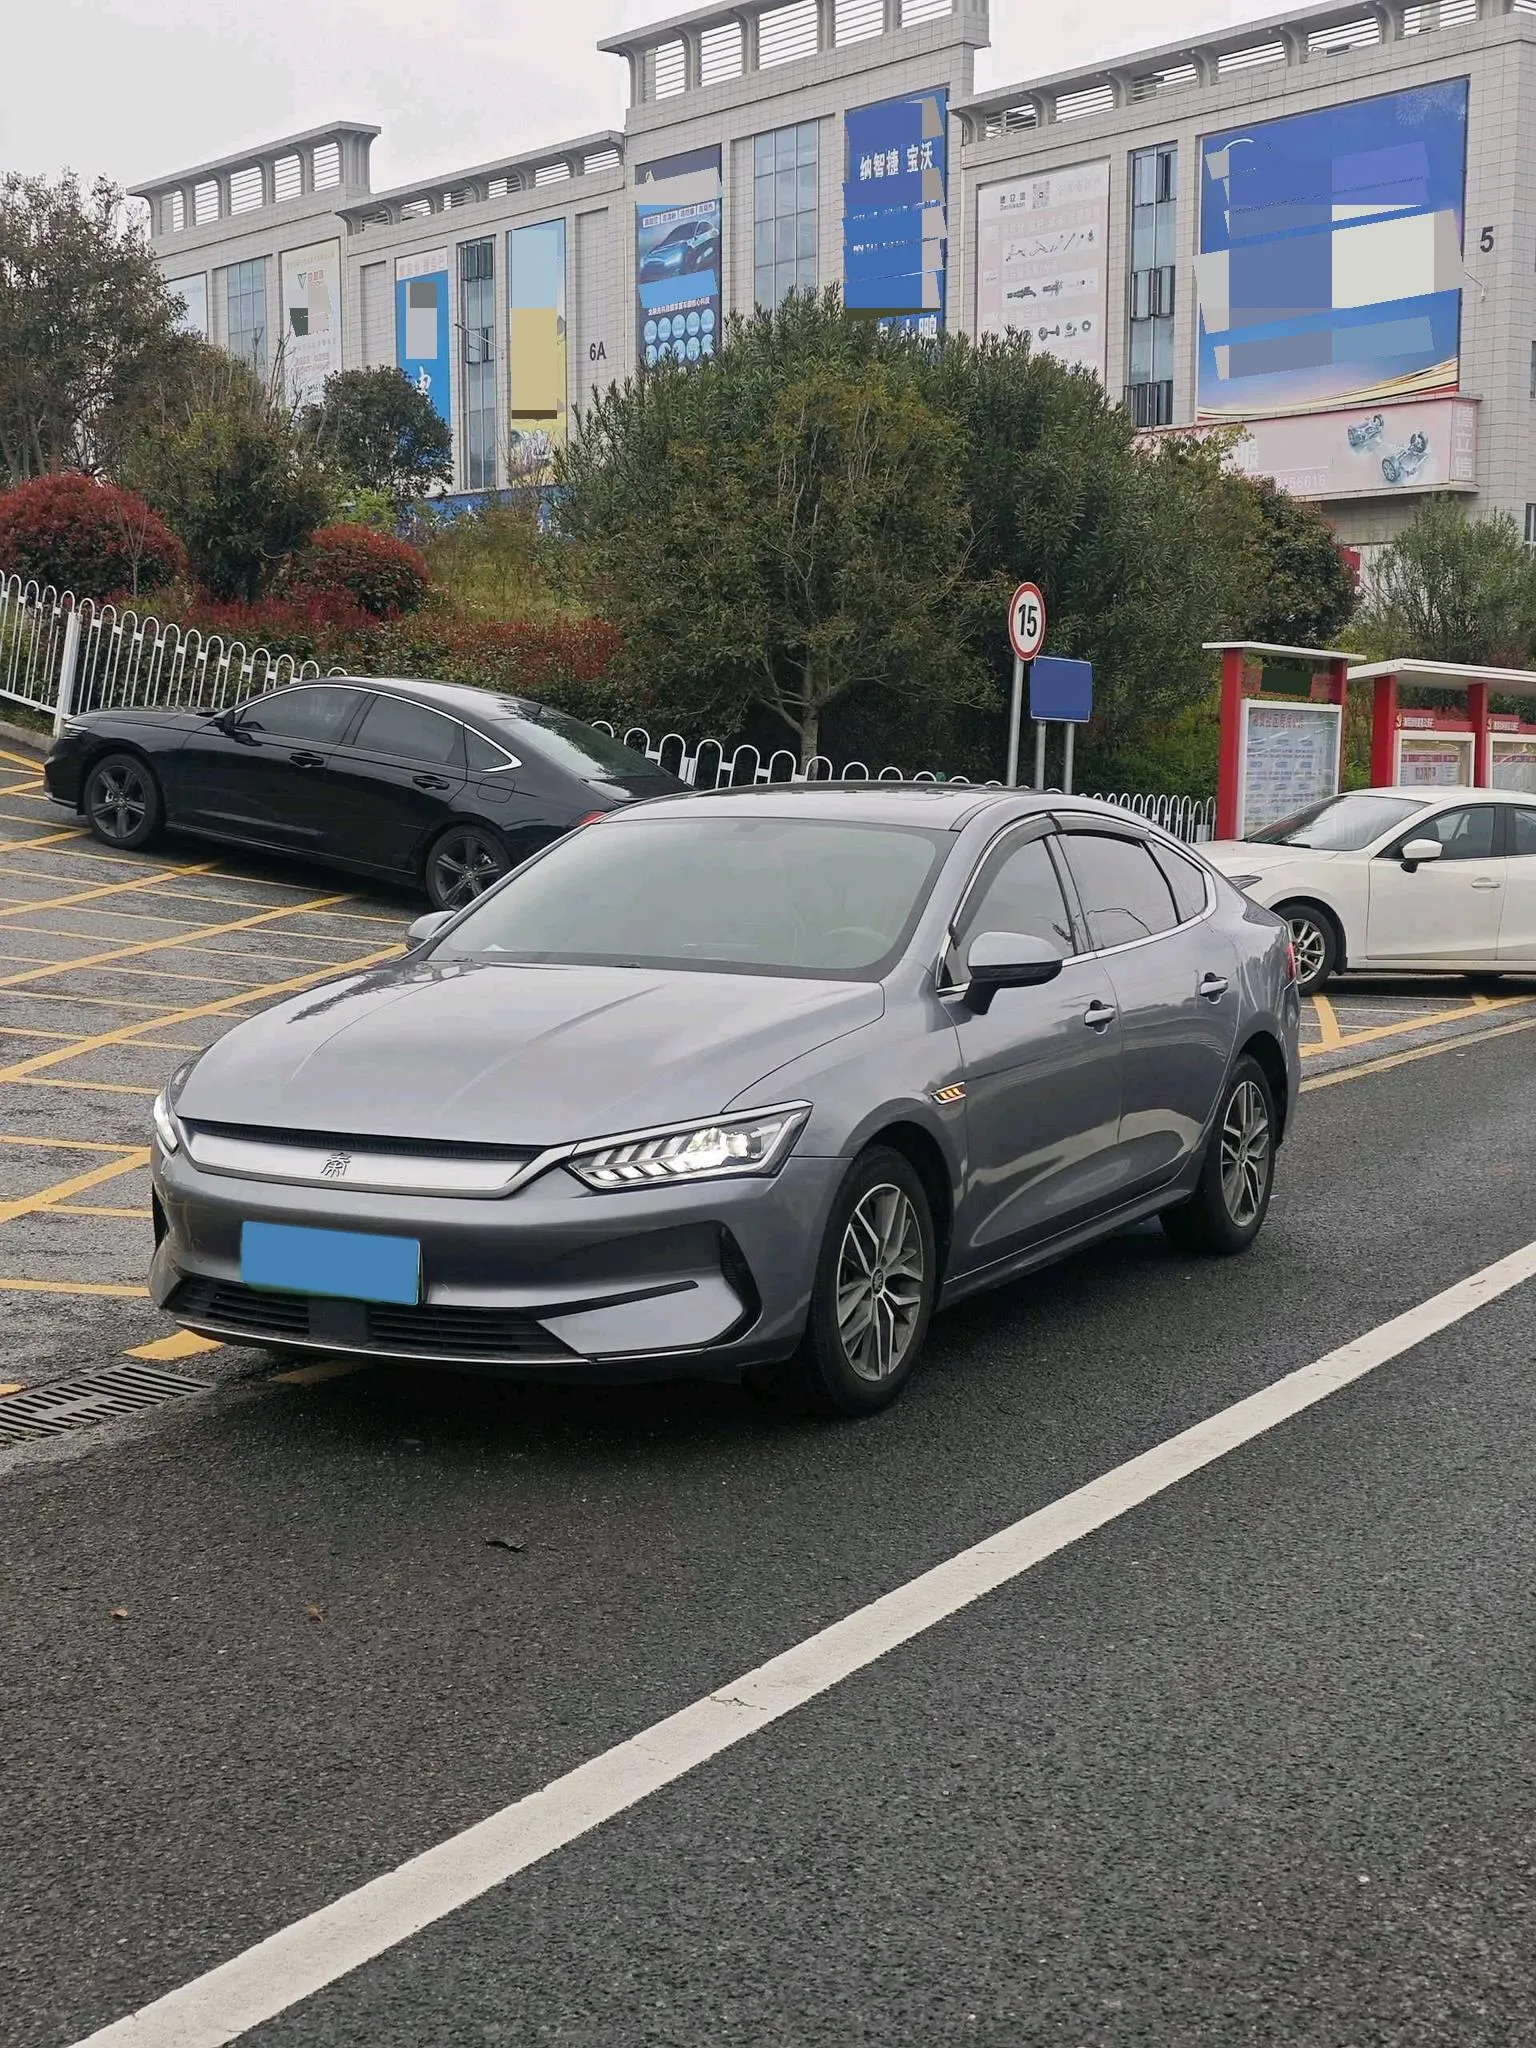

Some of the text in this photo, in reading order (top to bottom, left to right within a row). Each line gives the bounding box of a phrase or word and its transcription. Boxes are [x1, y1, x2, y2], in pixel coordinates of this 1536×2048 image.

[859, 141, 934, 181] 纳智捷 宝沃
[1480, 226, 1494, 253] 5
[590, 341, 607, 361] 6A
[1018, 604, 1038, 637] 15
